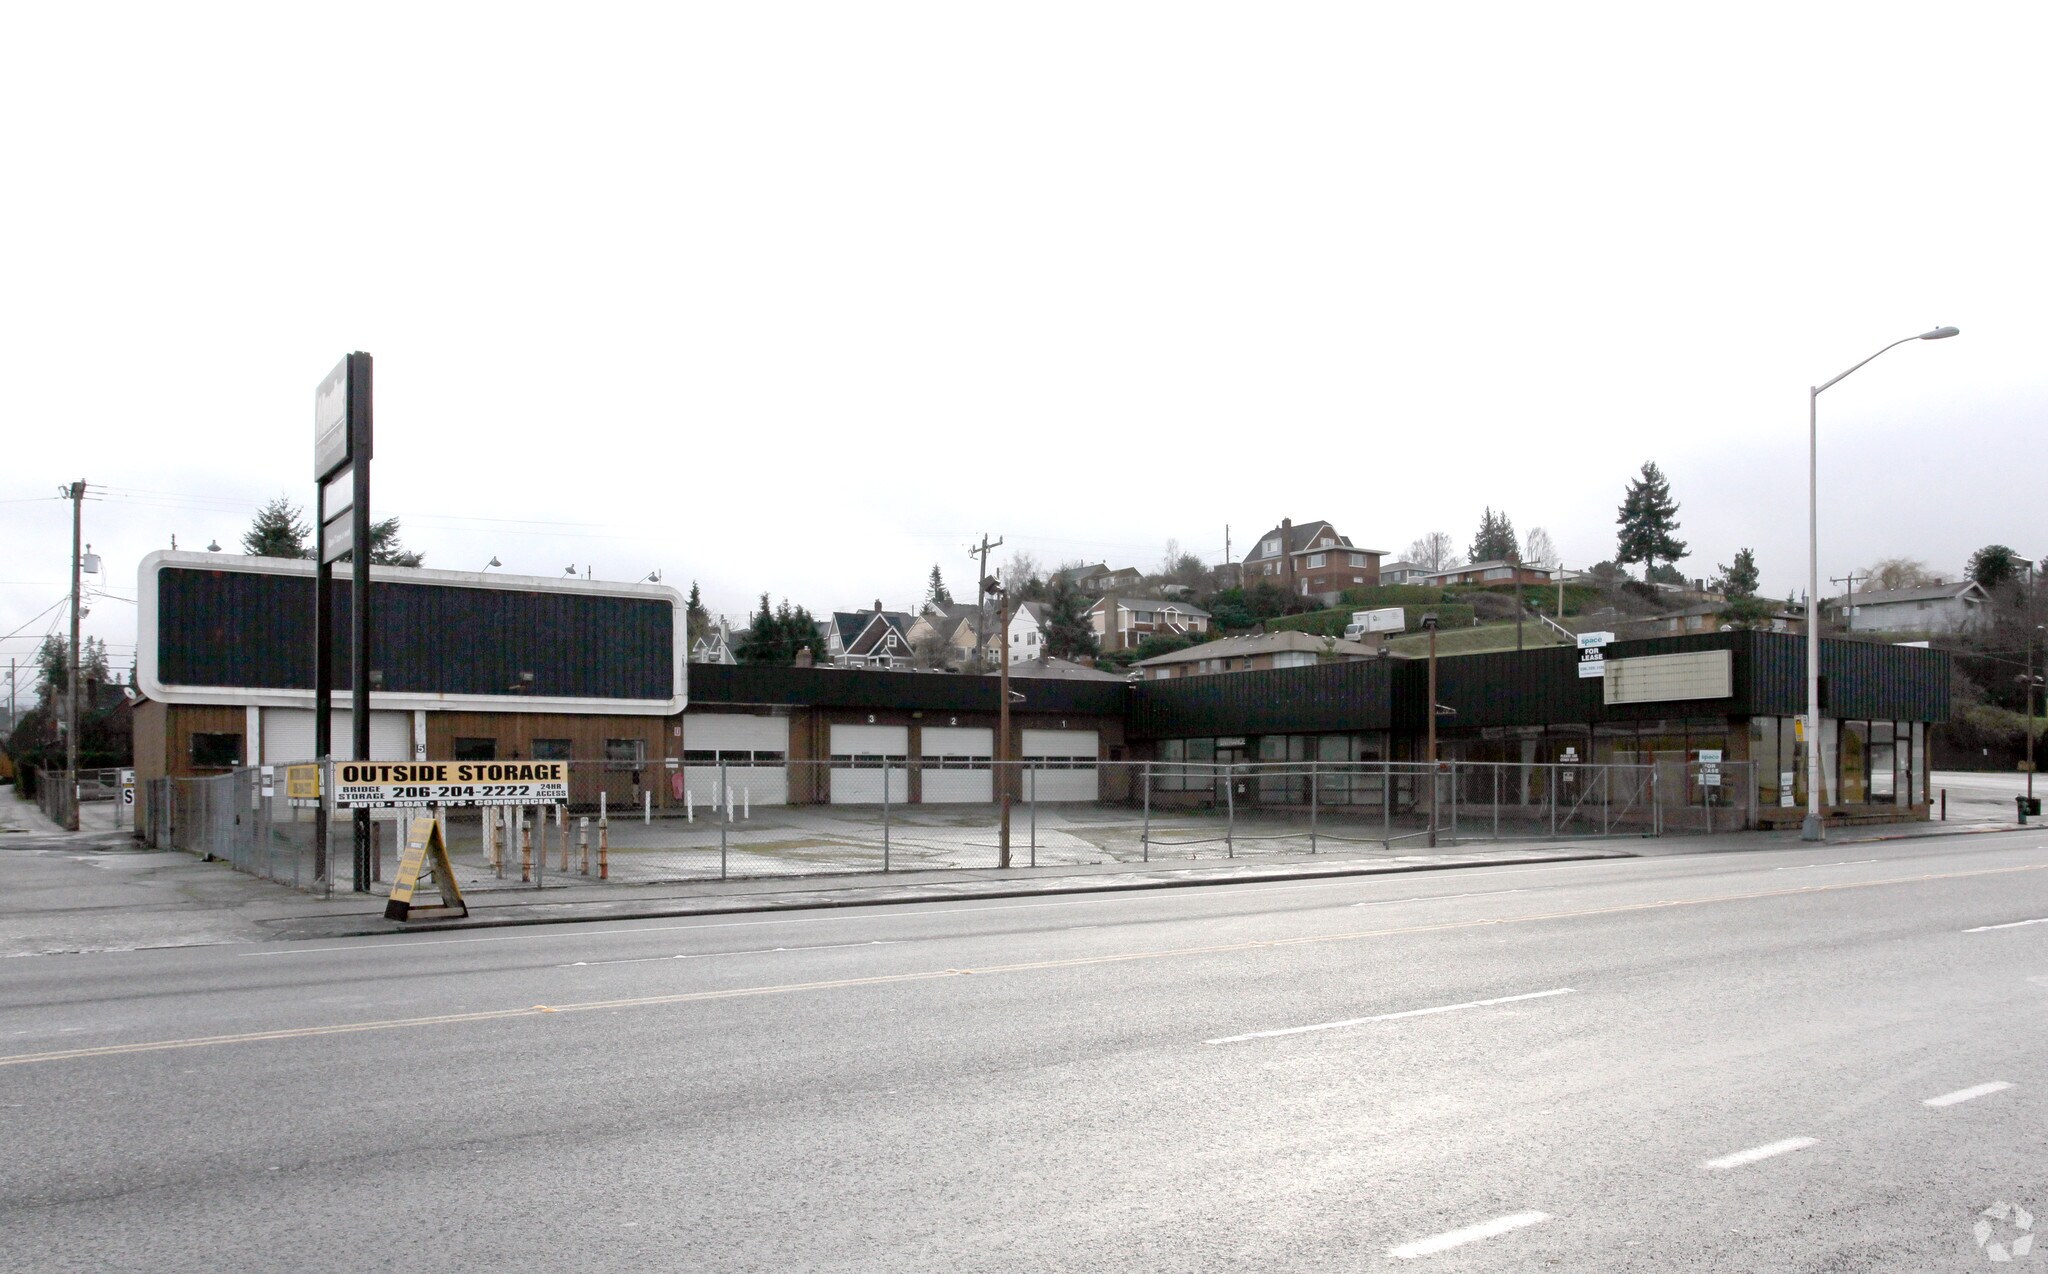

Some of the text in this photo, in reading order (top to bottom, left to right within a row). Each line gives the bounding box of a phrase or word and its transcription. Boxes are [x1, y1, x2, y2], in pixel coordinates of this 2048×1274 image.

[1581, 637, 1603, 646] space
[1584, 647, 1599, 655] FOR
[1581, 653, 1604, 662] LEASE
[868, 715, 875, 723] 3
[417, 744, 424, 753] 5
[342, 765, 448, 782] OUTSIDE
[458, 764, 561, 781] STORAGE
[342, 785, 381, 793] BRIDGE
[392, 785, 530, 798] 206-204-2222
[338, 792, 386, 800] STORAGE
[393, 800, 428, 808] BOAT
[474, 798, 558, 806] COMMERCIAL
